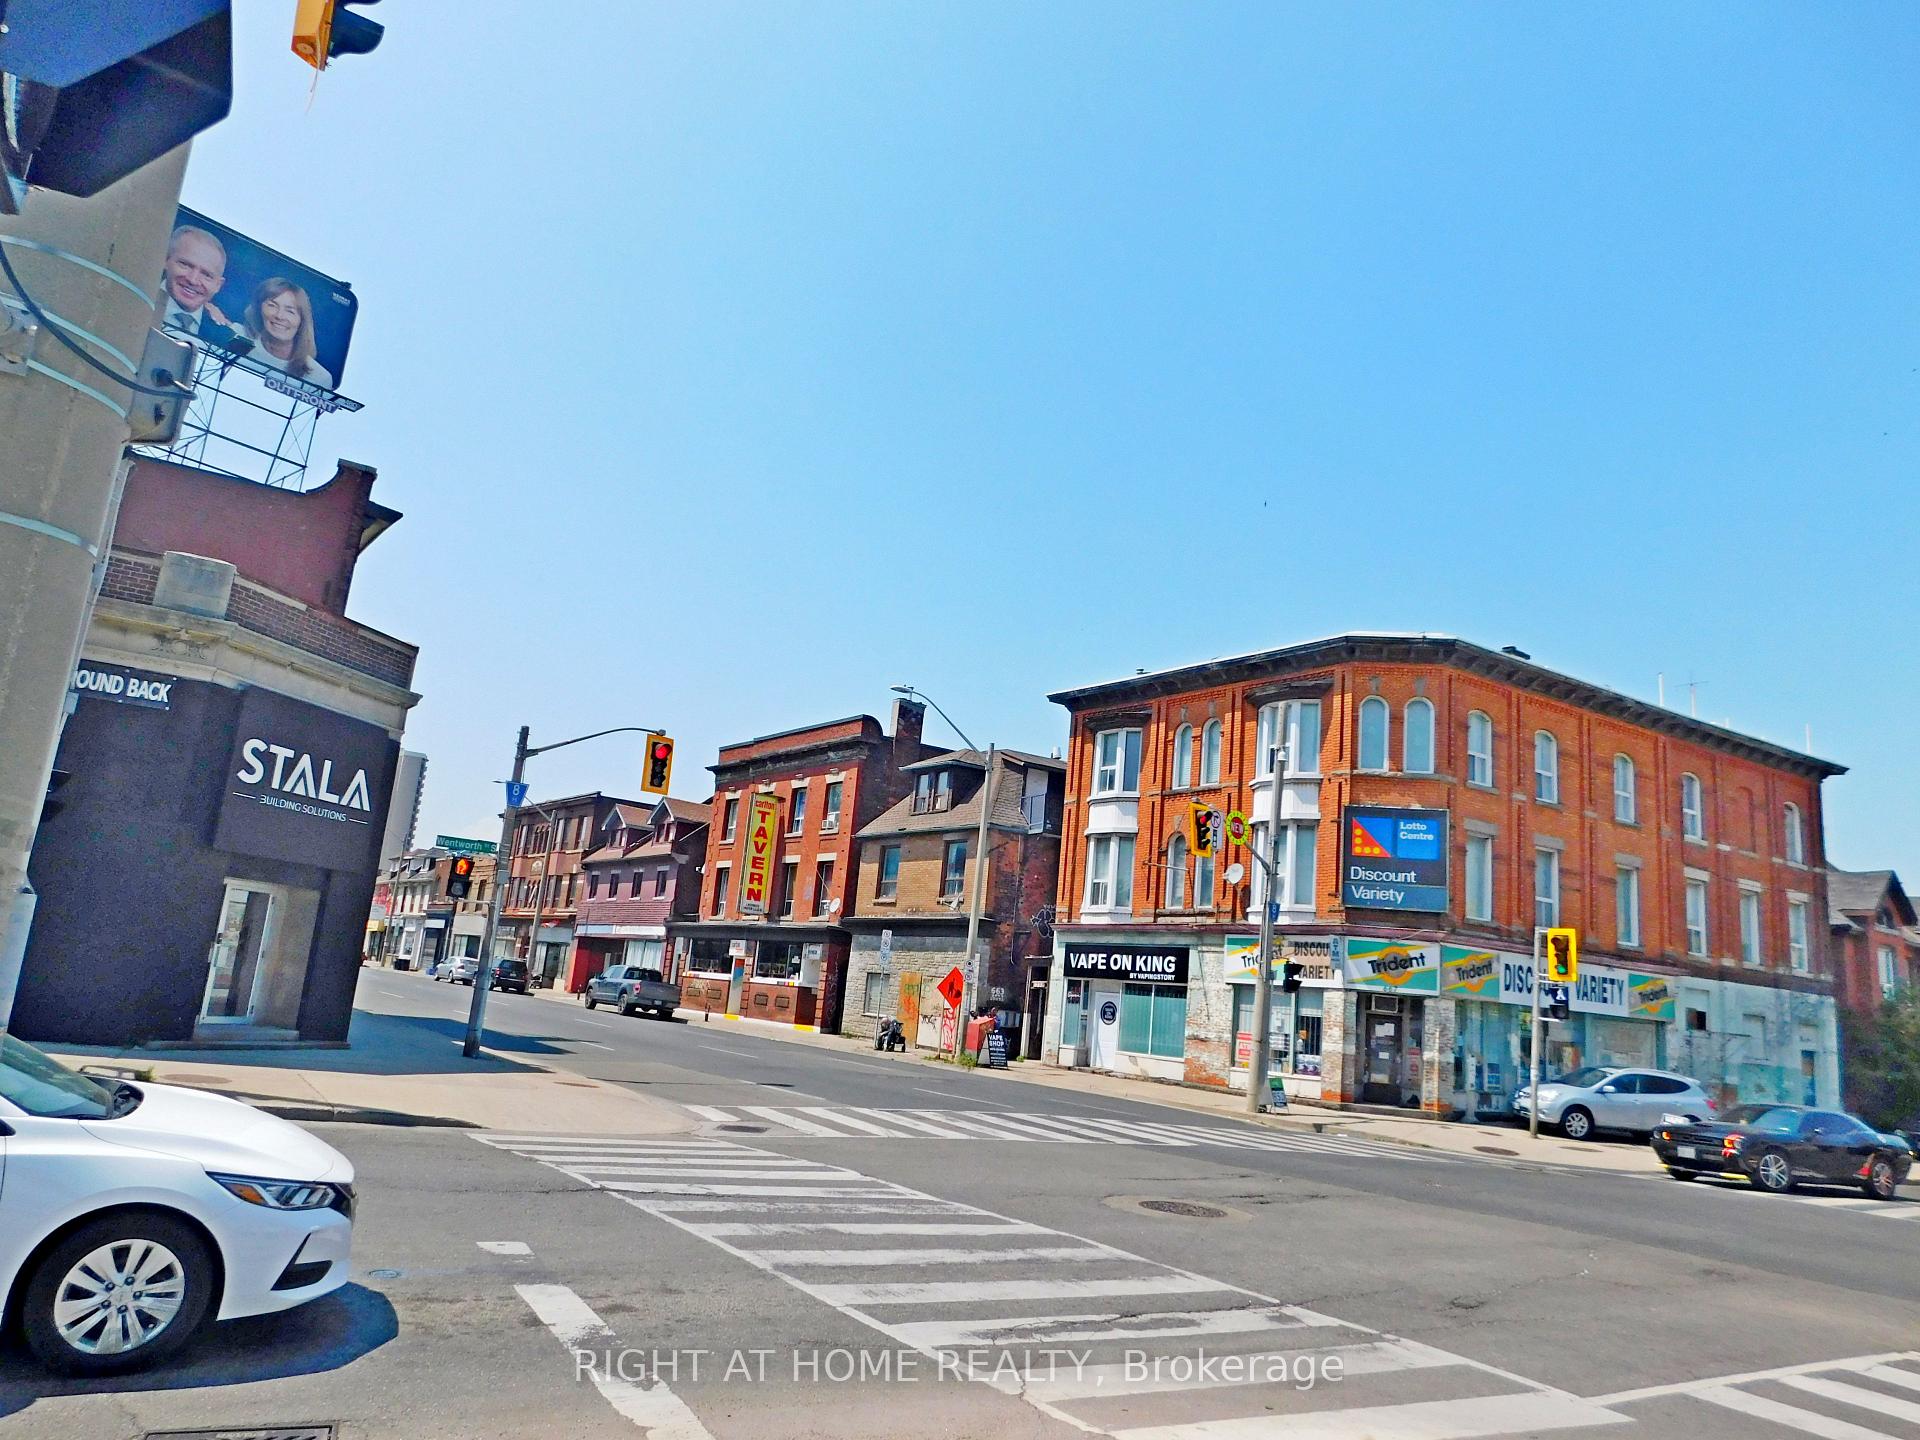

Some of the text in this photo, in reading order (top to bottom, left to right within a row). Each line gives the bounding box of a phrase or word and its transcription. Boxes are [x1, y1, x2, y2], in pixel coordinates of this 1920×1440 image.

[266, 379, 336, 412] OUTFRONT
[126, 678, 172, 702] BACK
[237, 738, 370, 811] STALA
[512, 785, 520, 796] 8
[260, 794, 347, 822] BUILDING SOLUTIONS
[1400, 822, 1427, 830] Lotto
[1400, 831, 1434, 840] Centre
[437, 837, 482, 850] Wentworth
[490, 844, 497, 852] S
[746, 810, 770, 902] TAVERN
[1350, 866, 1416, 882] Discount
[1351, 885, 1405, 904] Variety
[1069, 953, 1176, 973] VAPE ON KING
[1368, 953, 1425, 974] Trident
[1456, 960, 1492, 981] Trident
[1576, 973, 1624, 1005] VARIETY
